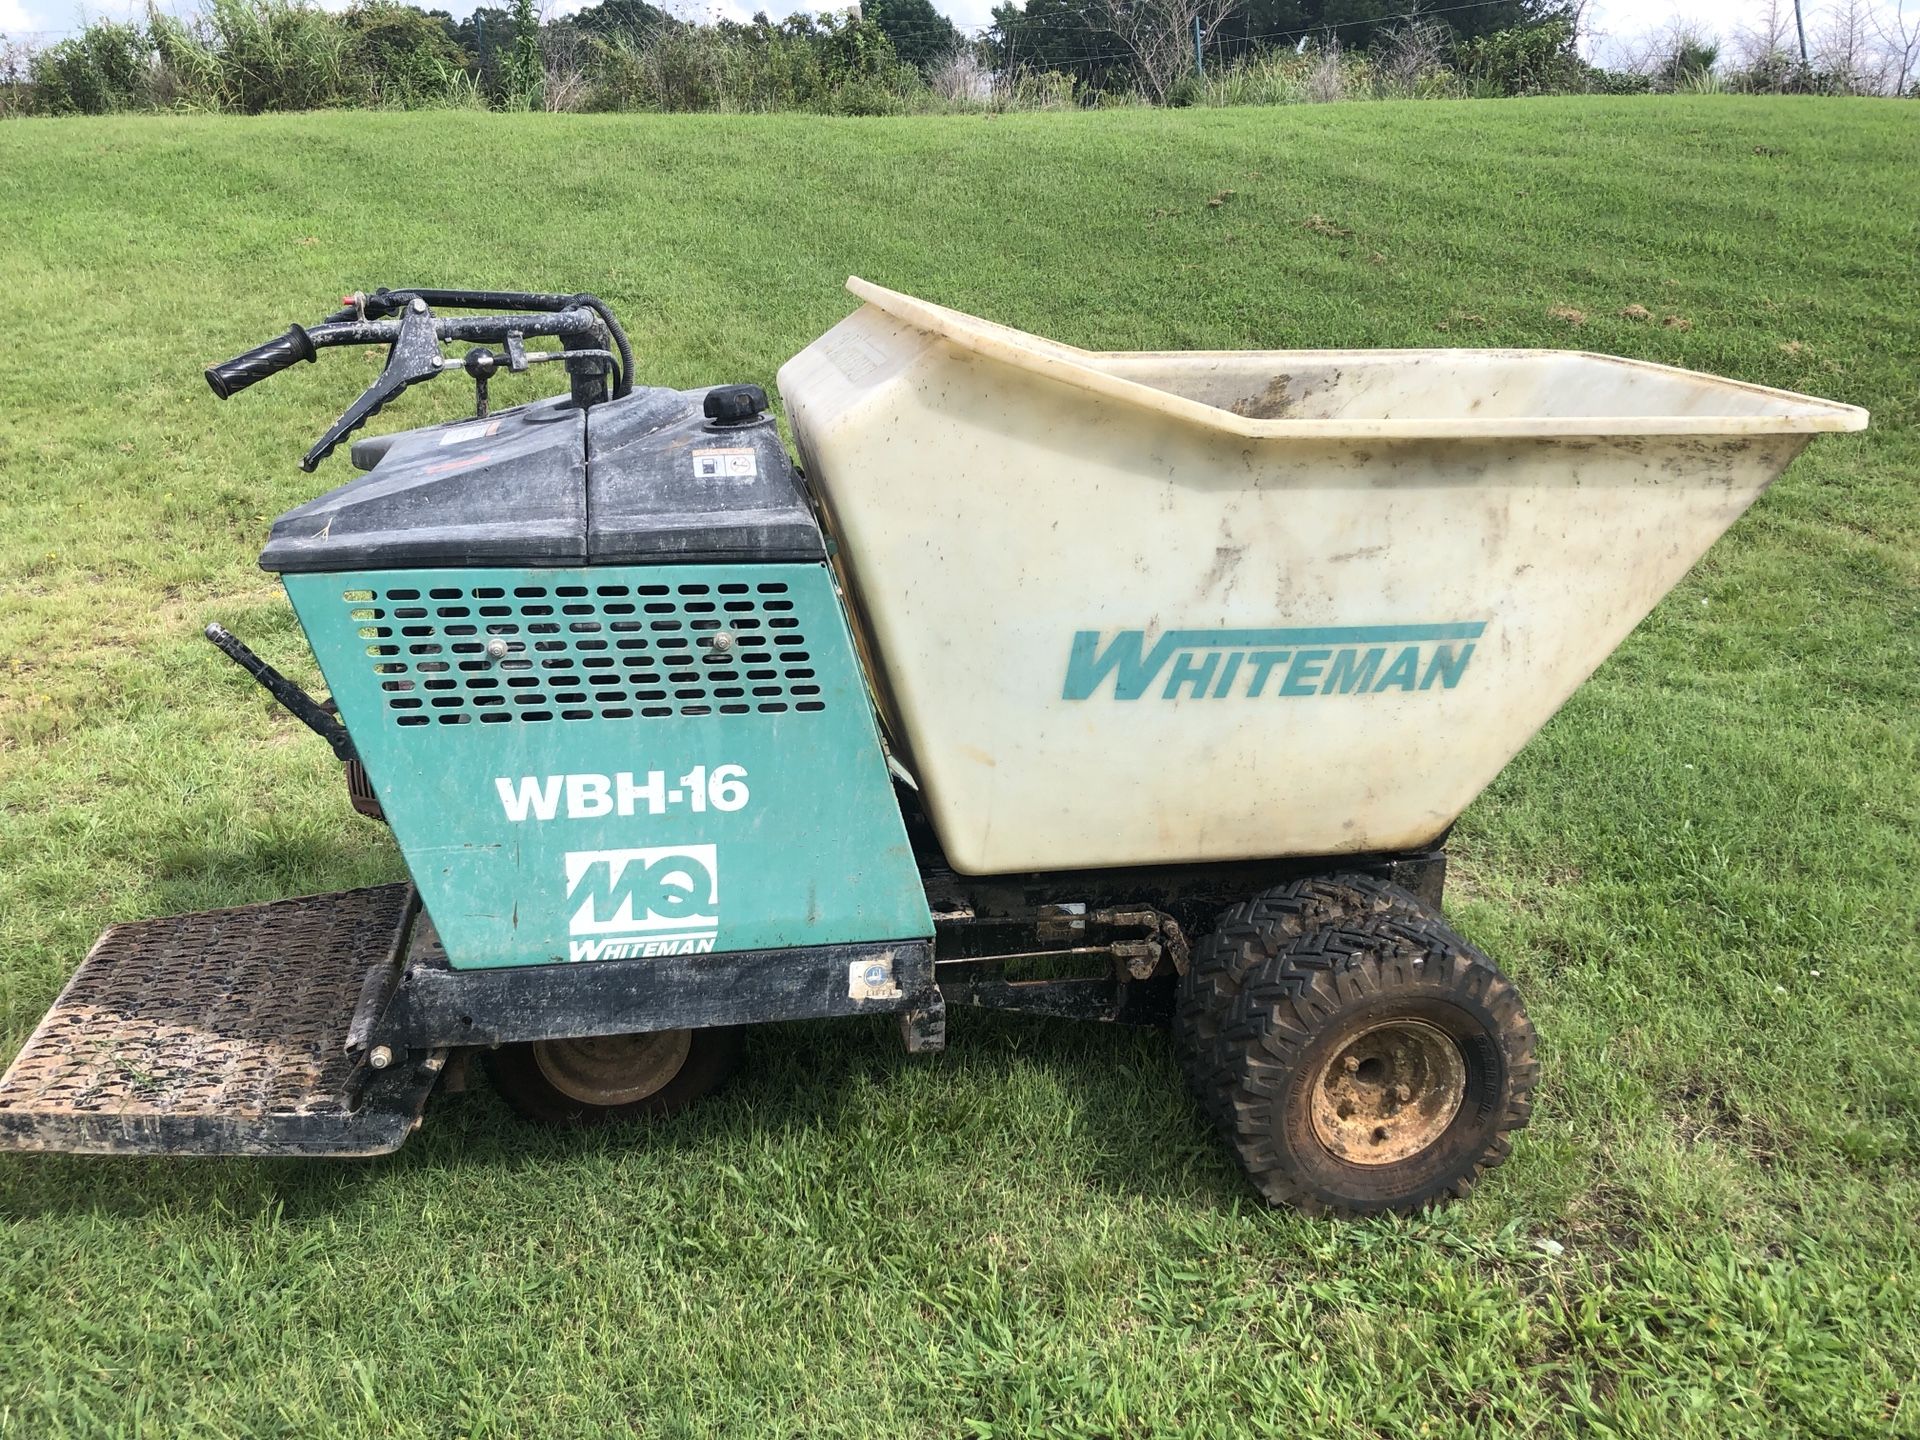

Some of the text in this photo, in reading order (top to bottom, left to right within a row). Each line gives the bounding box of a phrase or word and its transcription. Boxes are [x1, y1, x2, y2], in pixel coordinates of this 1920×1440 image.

[1062, 621, 1487, 700] WHITEMAN
[495, 764, 750, 822] WBH-16
[567, 850, 718, 925] MQ
[569, 931, 718, 962] WHITEMAN
